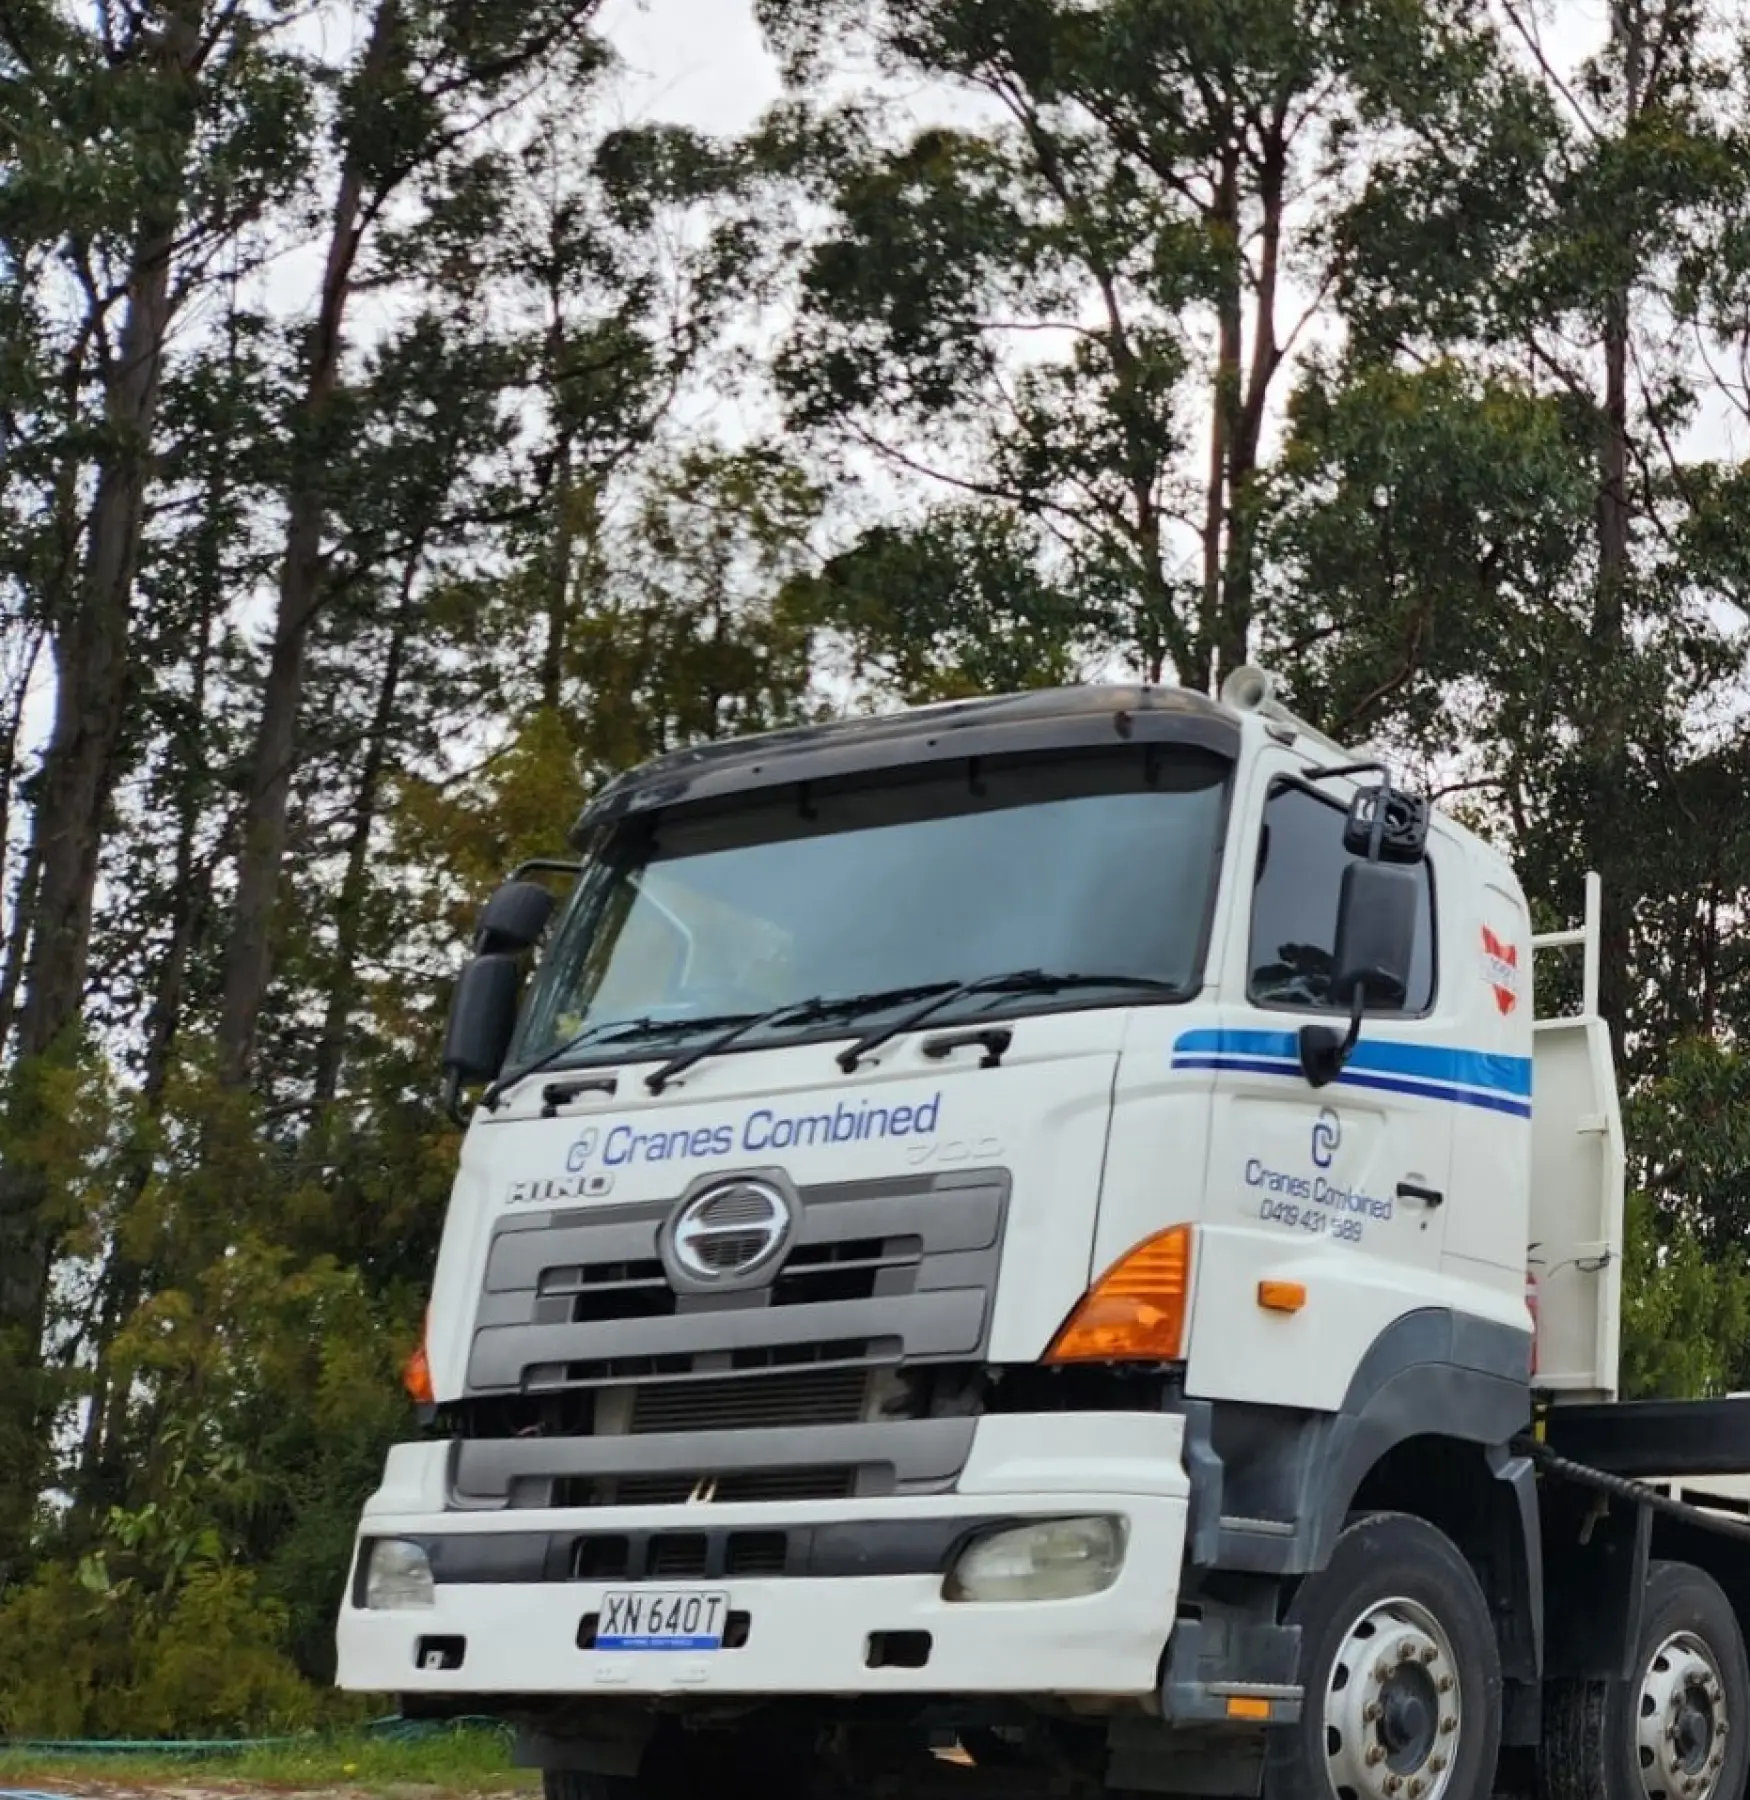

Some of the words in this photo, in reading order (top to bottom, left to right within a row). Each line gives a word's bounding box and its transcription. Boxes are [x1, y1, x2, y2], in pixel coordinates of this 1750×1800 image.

[602, 1123, 733, 1166] Cranes
[742, 1092, 942, 1151] Combined
[506, 1172, 614, 1205] HINO
[1246, 1159, 1310, 1198] Cranes
[1313, 1177, 1393, 1220] Combined
[603, 1597, 641, 1633] XN
